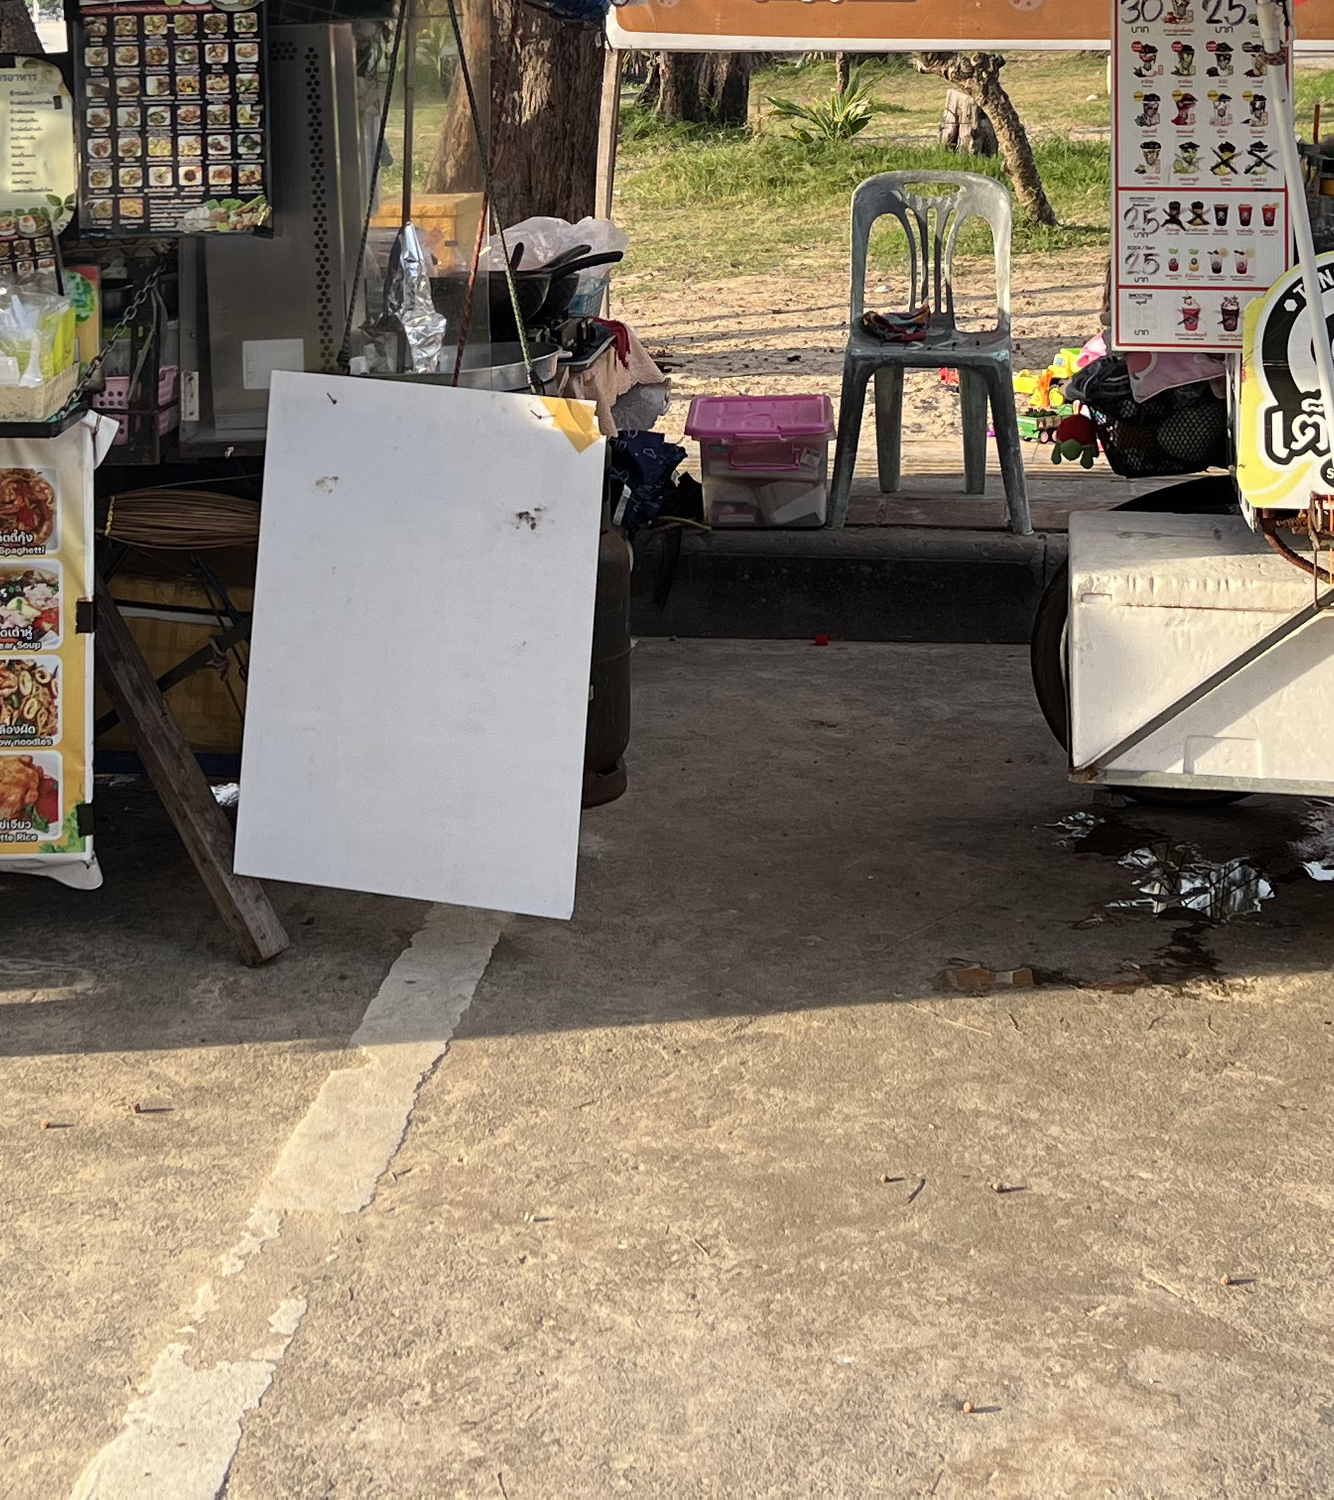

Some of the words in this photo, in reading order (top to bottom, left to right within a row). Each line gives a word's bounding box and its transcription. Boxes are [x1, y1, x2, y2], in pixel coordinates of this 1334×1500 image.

[1123, 206, 1160, 235] 25
[16, 640, 41, 651] Soup
[14, 737, 53, 747] noodles
[15, 833, 38, 842] Rice
